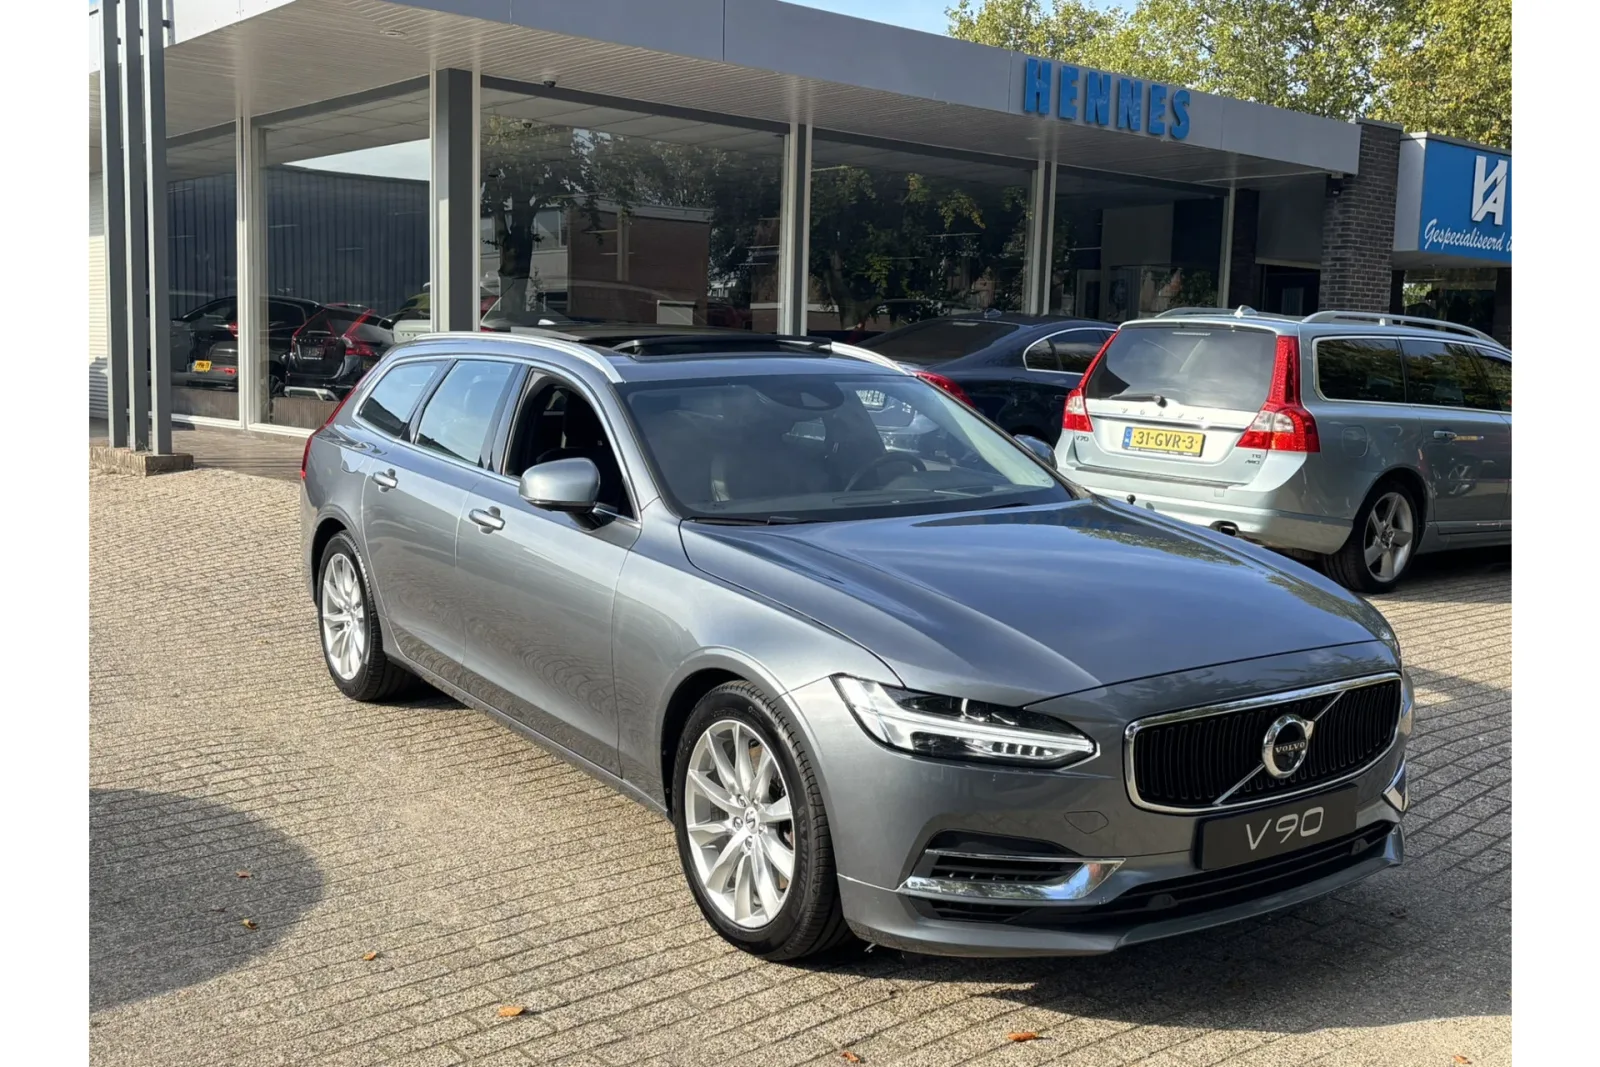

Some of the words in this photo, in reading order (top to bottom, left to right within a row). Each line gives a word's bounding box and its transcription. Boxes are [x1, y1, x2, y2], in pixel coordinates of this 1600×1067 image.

[1024, 58, 1191, 140] HENNES
[1424, 218, 1505, 250] Gespecialiseerd
[1136, 431, 1194, 450] 31-GVR-3
[1275, 741, 1305, 754] VOLVO
[1246, 806, 1324, 850] V90
